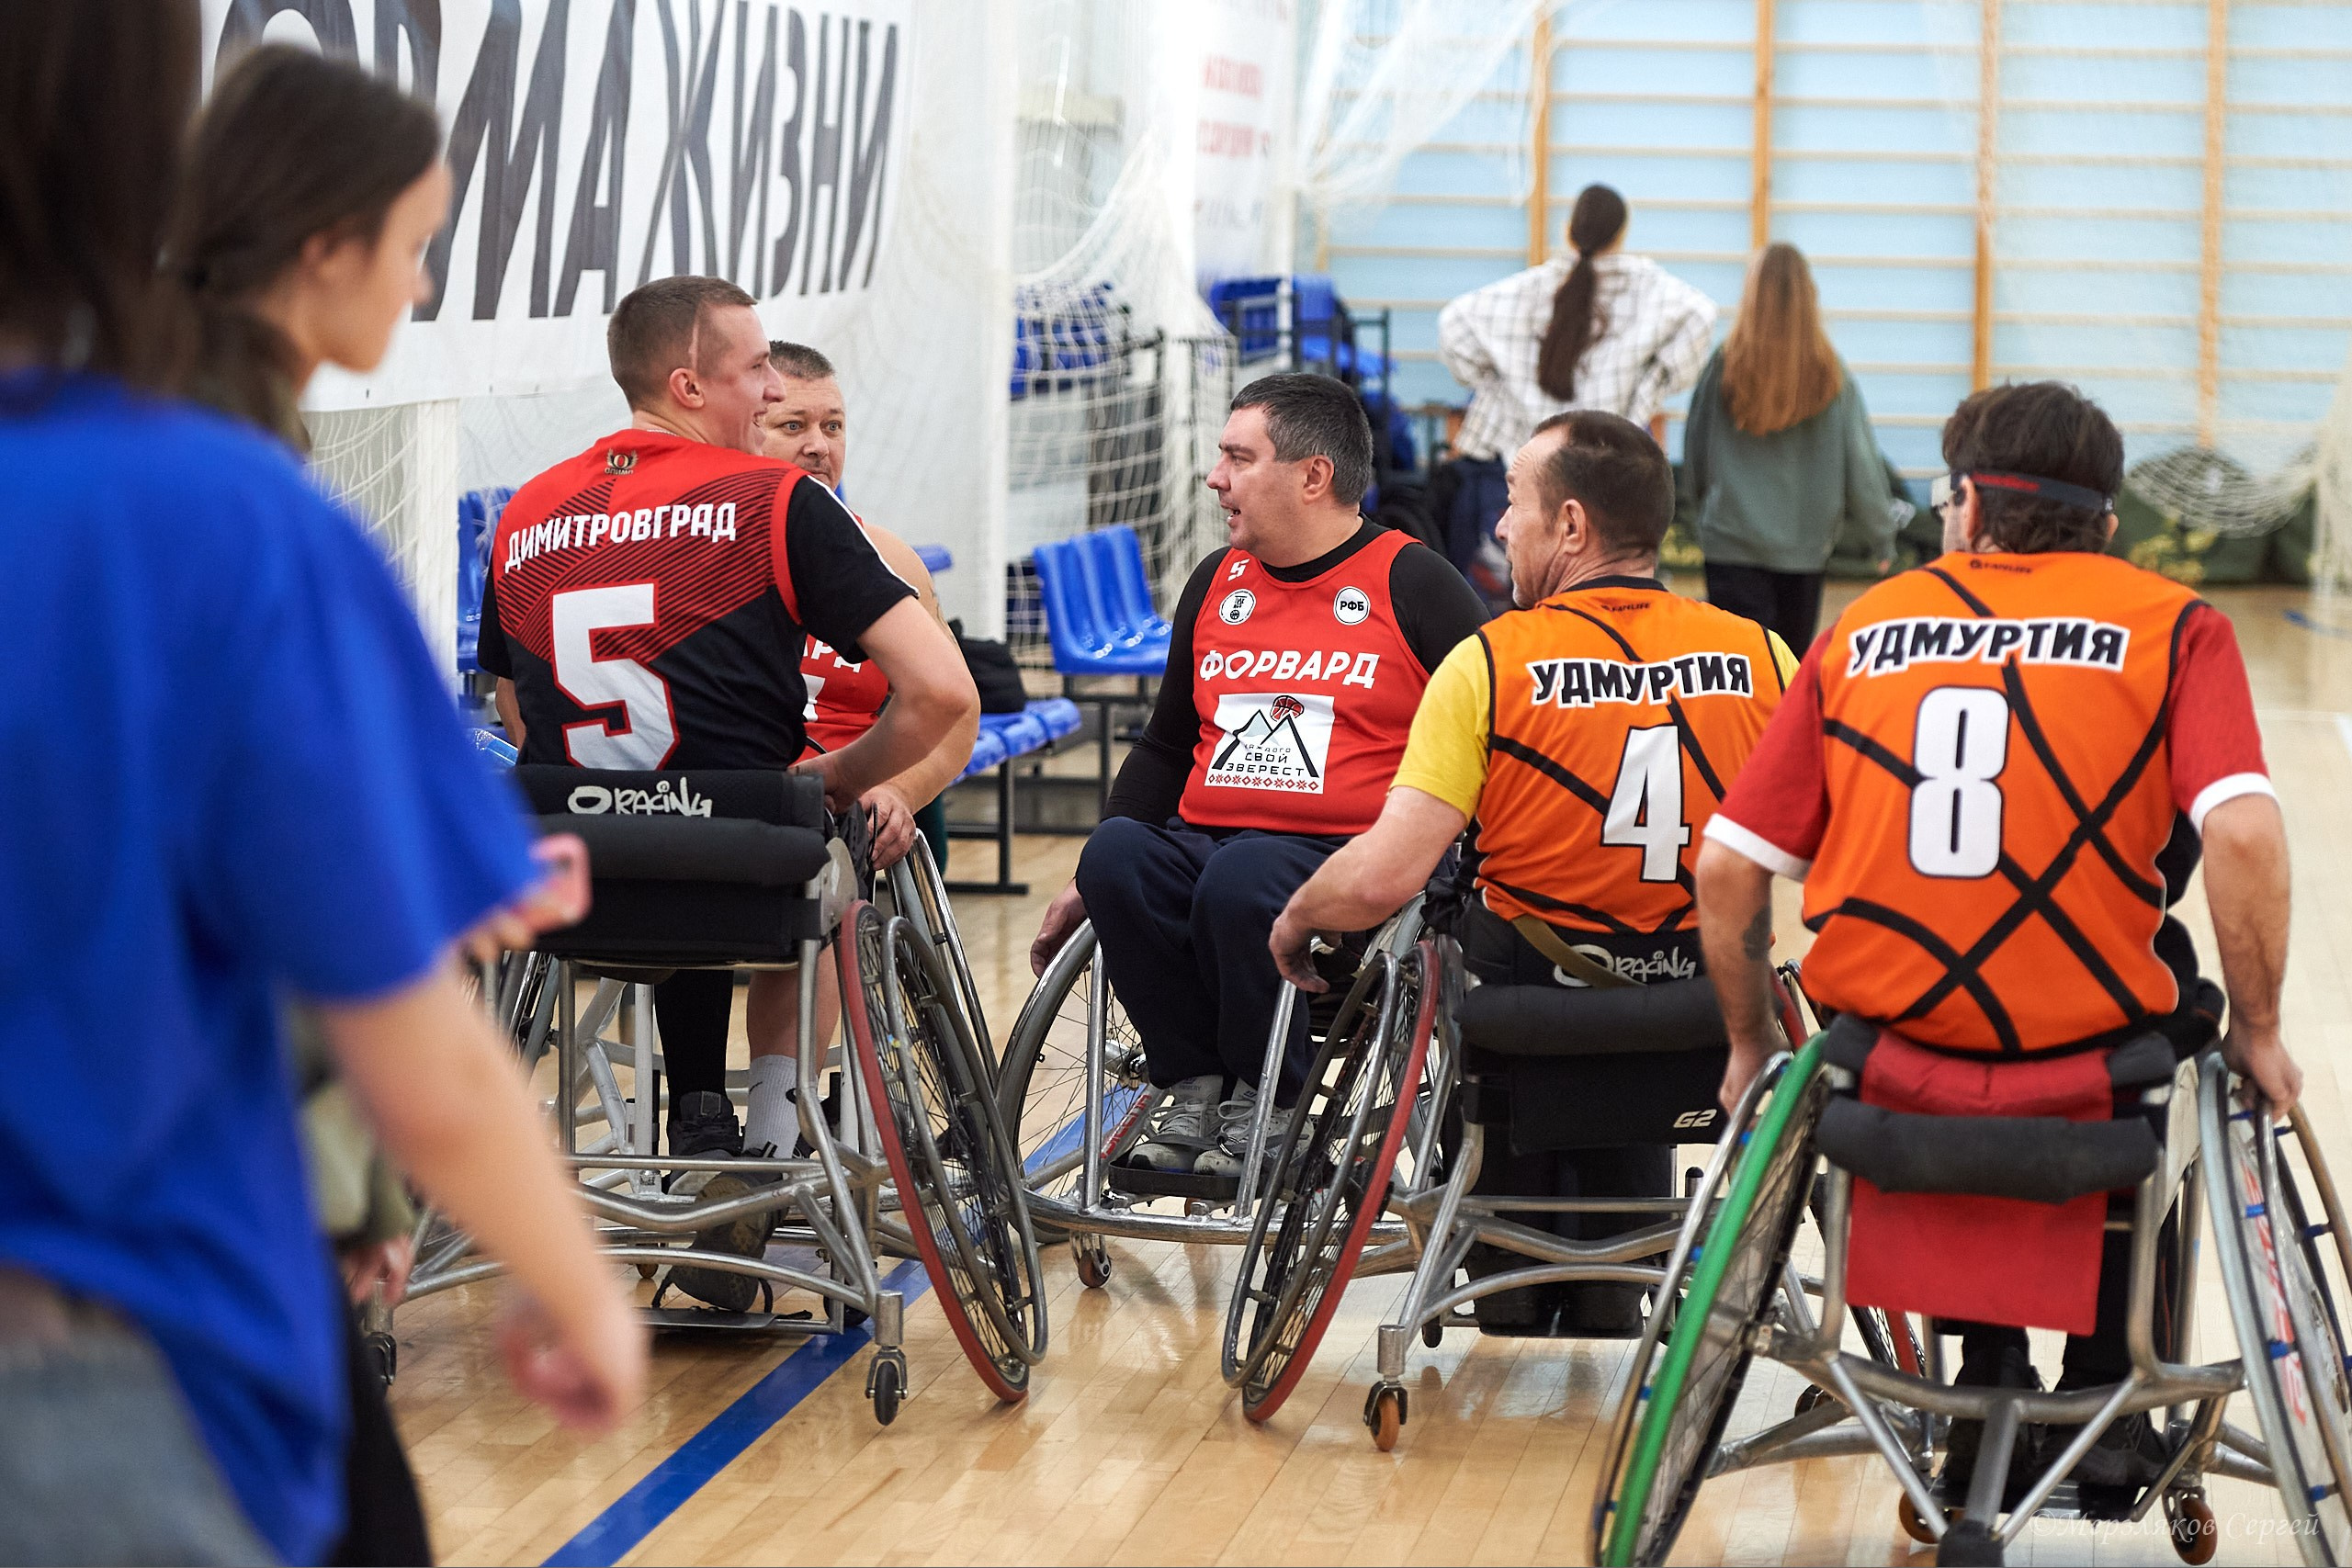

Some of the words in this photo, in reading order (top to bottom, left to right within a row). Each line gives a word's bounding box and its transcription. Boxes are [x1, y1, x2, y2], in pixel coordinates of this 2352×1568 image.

[636, 0, 899, 300] ЖИЗНИ
[504, 502, 737, 574] ДИМИТРОВГРАД
[1340, 600, 1364, 612] РФБ
[550, 580, 680, 772] 5
[1199, 649, 1380, 689] ФОРВАРД
[1848, 618, 2130, 677] УДМУРТИЯ
[1528, 652, 1753, 707] УДМУРТИЯ
[1245, 752, 1288, 764] СВОЙ
[1908, 684, 2010, 879] 8
[1601, 723, 1690, 883] 4
[1673, 1108, 1717, 1128] G2
